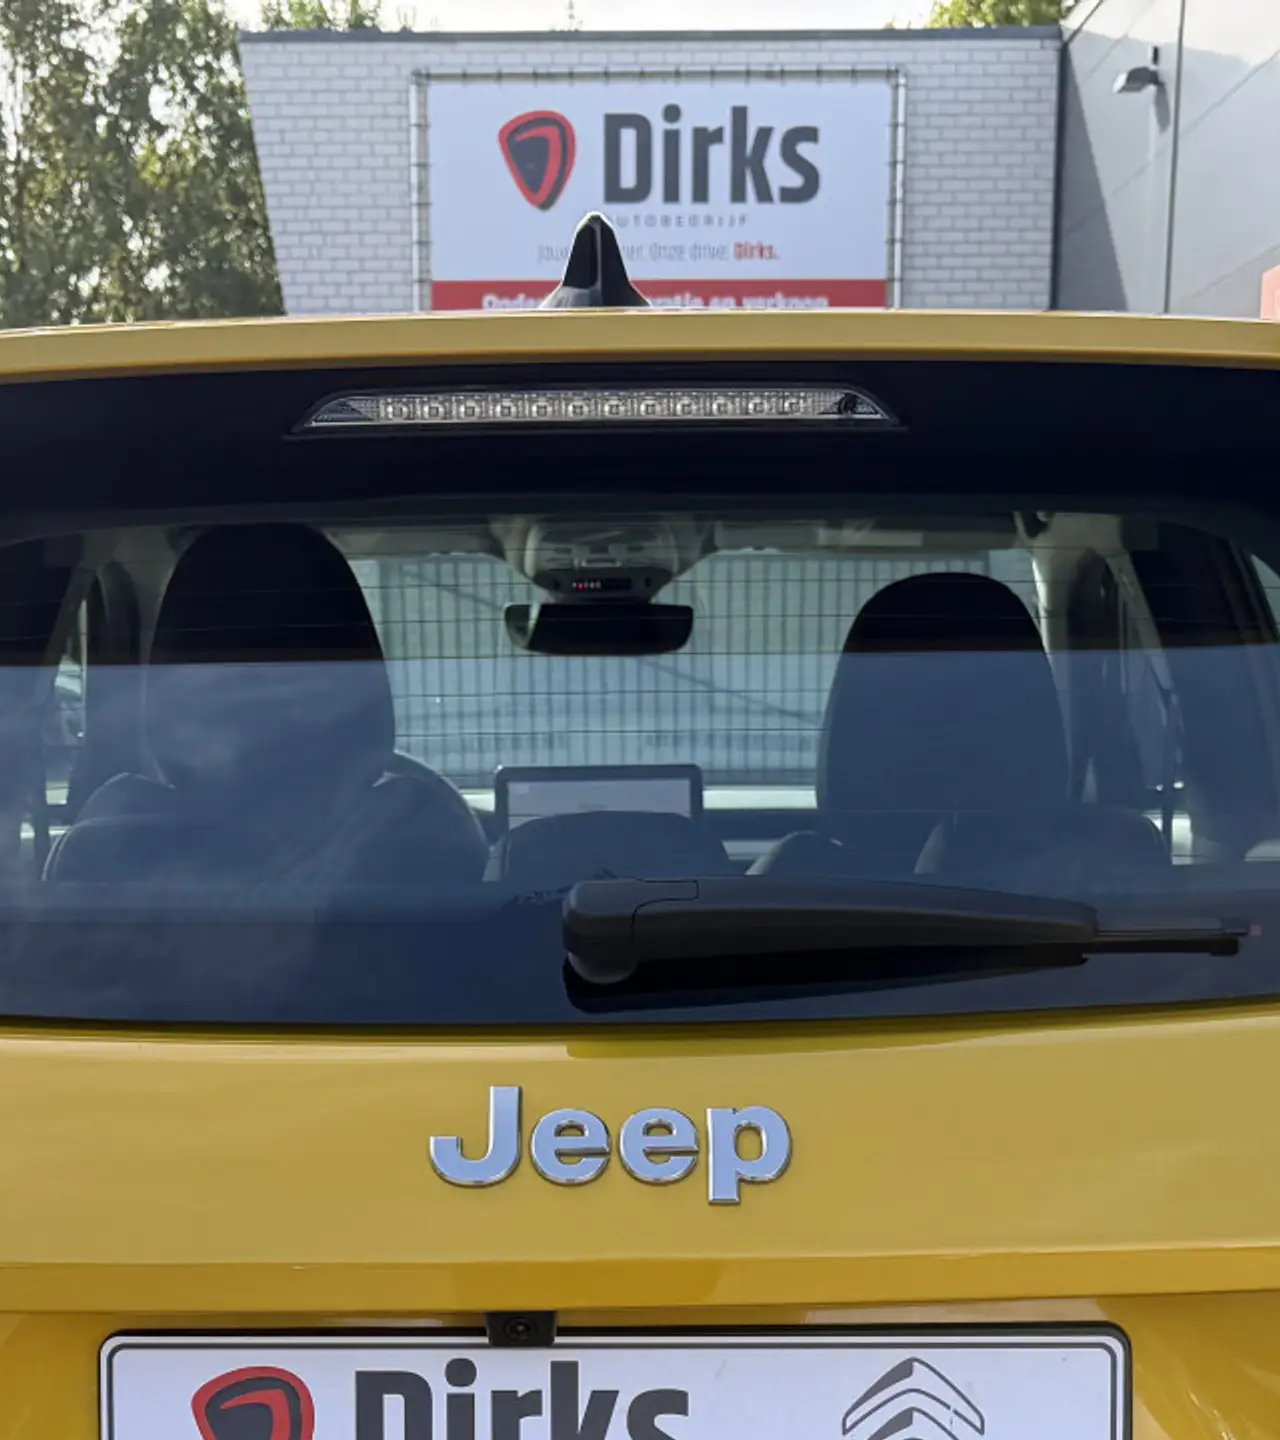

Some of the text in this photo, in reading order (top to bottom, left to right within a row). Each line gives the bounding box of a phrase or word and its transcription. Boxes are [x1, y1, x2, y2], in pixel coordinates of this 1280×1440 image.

[603, 103, 821, 204] Dirks
[609, 214, 749, 228] UTOBEDRIJF
[429, 1085, 793, 1205] Jeep
